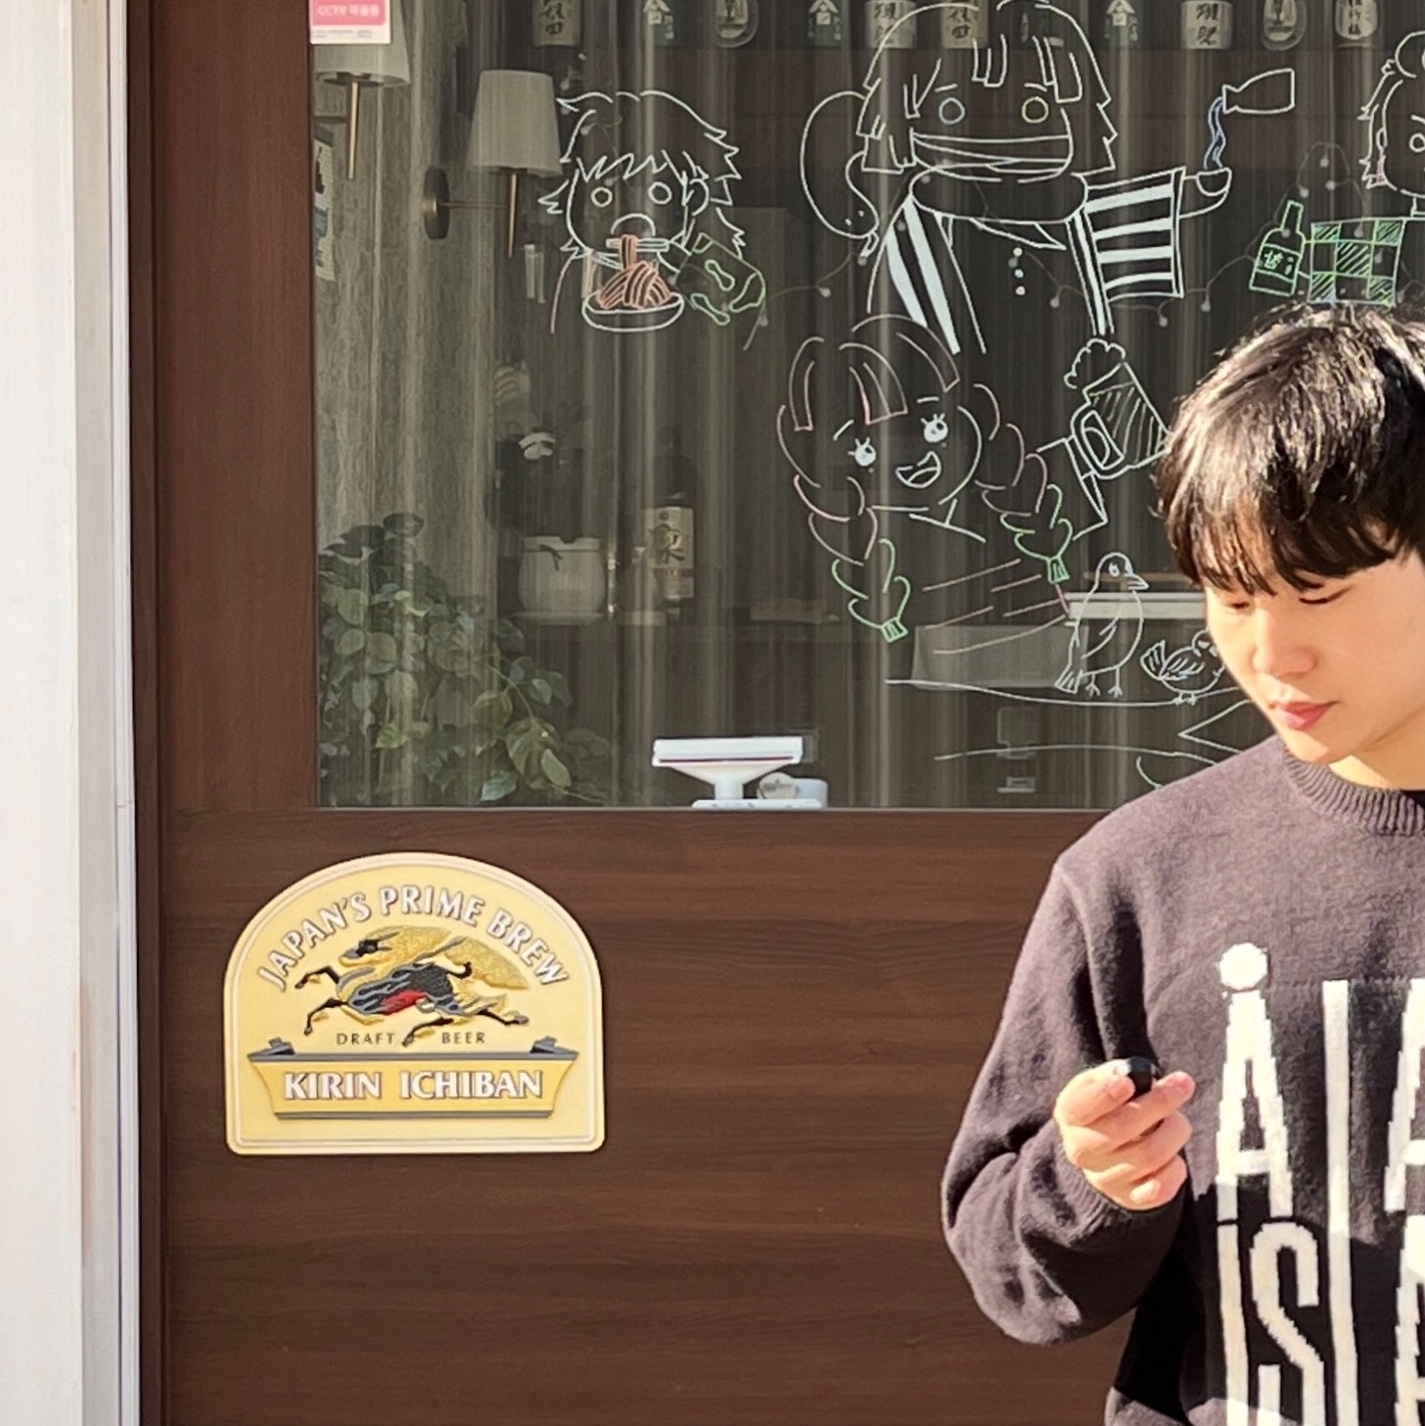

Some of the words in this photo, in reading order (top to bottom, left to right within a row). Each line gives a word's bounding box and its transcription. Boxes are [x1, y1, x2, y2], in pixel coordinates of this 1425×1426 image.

[256, 893, 373, 992] JAPAN'S
[378, 884, 487, 926] PRIME
[485, 907, 570, 987] BREW
[336, 1031, 396, 1046] DRAFT
[441, 1031, 486, 1045] BEER
[283, 1071, 382, 1100] KIRIN
[399, 1070, 544, 1100] ICHIBAN
